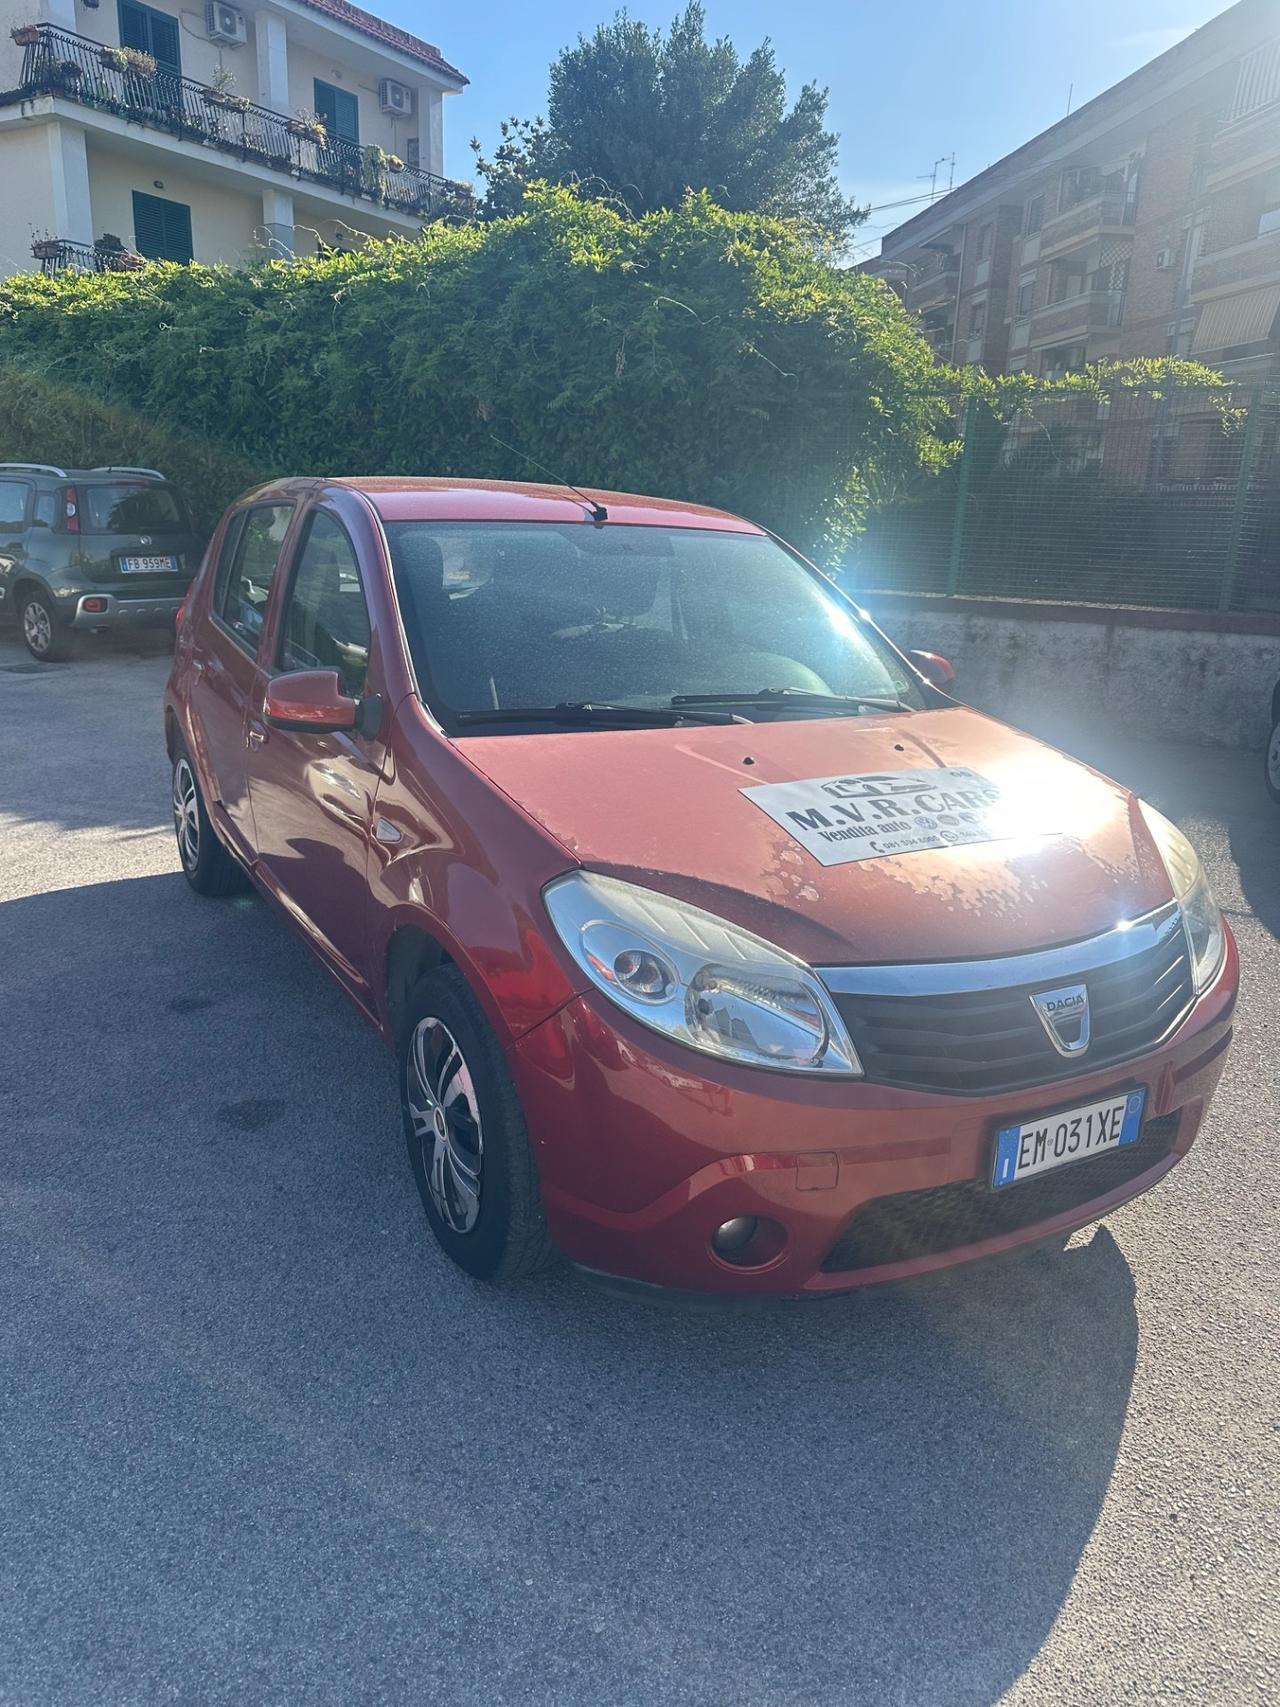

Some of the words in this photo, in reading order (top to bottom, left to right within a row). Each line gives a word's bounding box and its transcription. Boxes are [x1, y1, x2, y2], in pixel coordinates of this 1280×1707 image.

[128, 558, 140, 569] FB
[142, 557, 171, 569] 959ME
[817, 825, 879, 842] Vendita
[877, 820, 912, 833] auto
[1046, 995, 1085, 1011] DACIA
[1018, 1127, 1048, 1170] EM
[1053, 1105, 1125, 1158] 031XE
